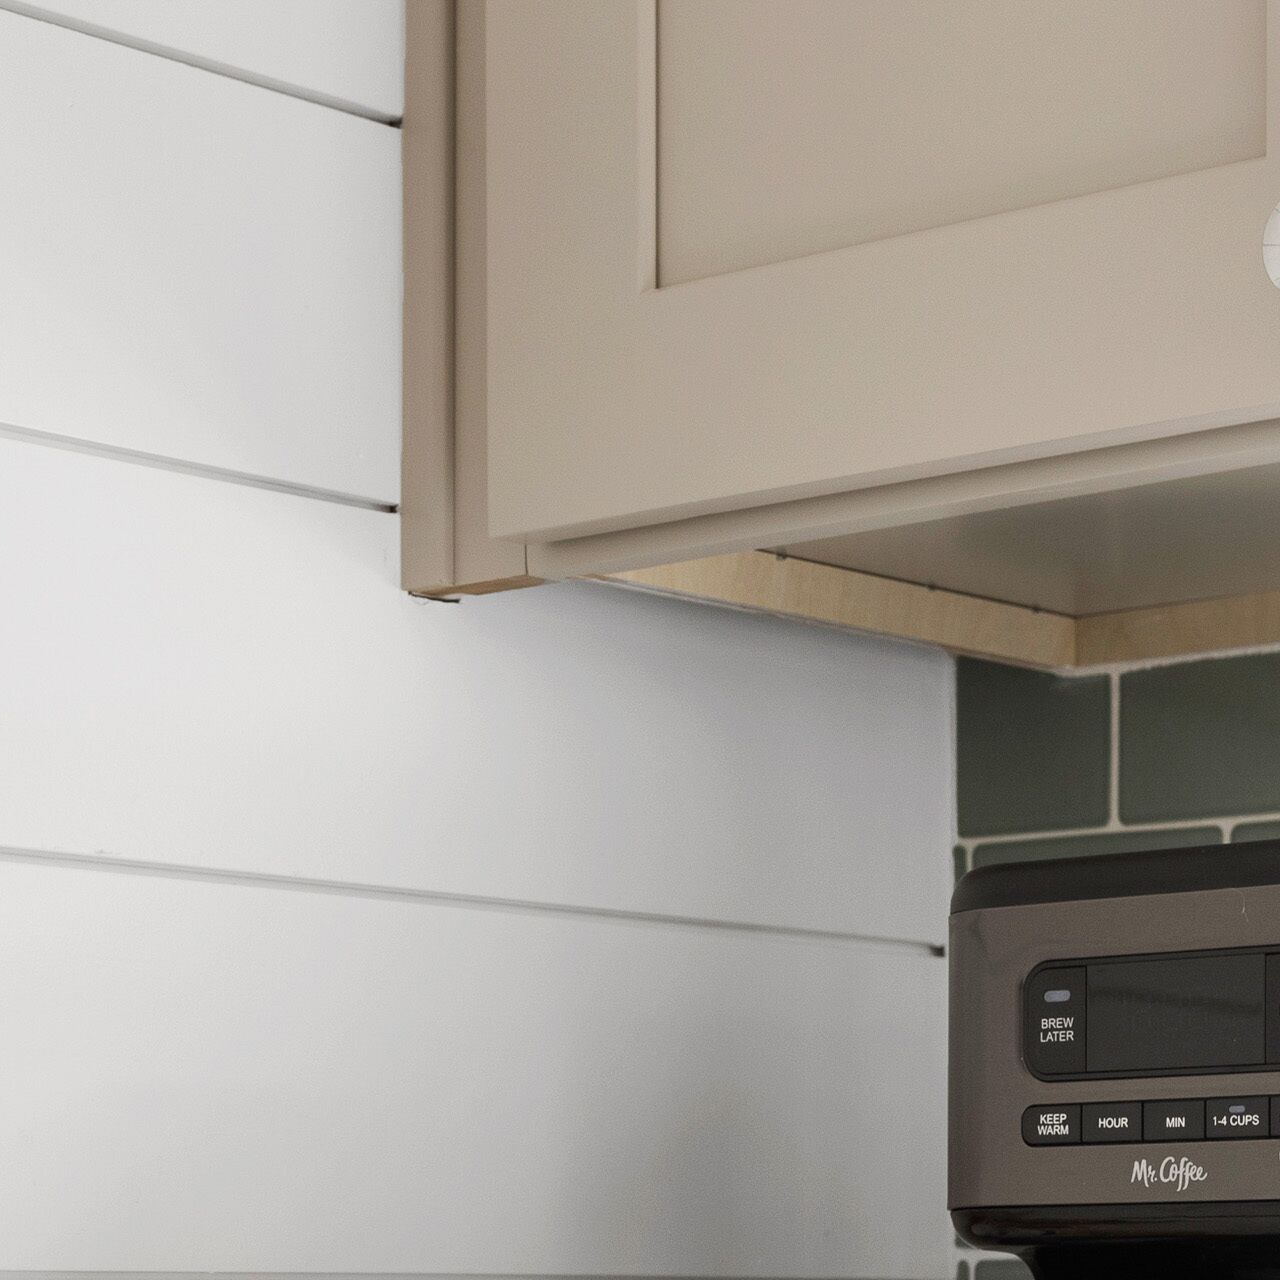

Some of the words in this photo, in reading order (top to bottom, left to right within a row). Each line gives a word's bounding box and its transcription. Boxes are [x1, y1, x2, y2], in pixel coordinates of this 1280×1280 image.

[1041, 1017, 1074, 1029] BREW
[1040, 1031, 1074, 1042] LATER
[1040, 1114, 1067, 1124] KEEP
[1098, 1117, 1128, 1128] HOUR
[1166, 1117, 1185, 1128] MIN
[1213, 1116, 1227, 1126] 1-4
[1229, 1114, 1259, 1126] CUPS
[1038, 1125, 1069, 1135] WARM
[1130, 1160, 1158, 1187] Mr.
[1160, 1156, 1208, 1191] Coffee
